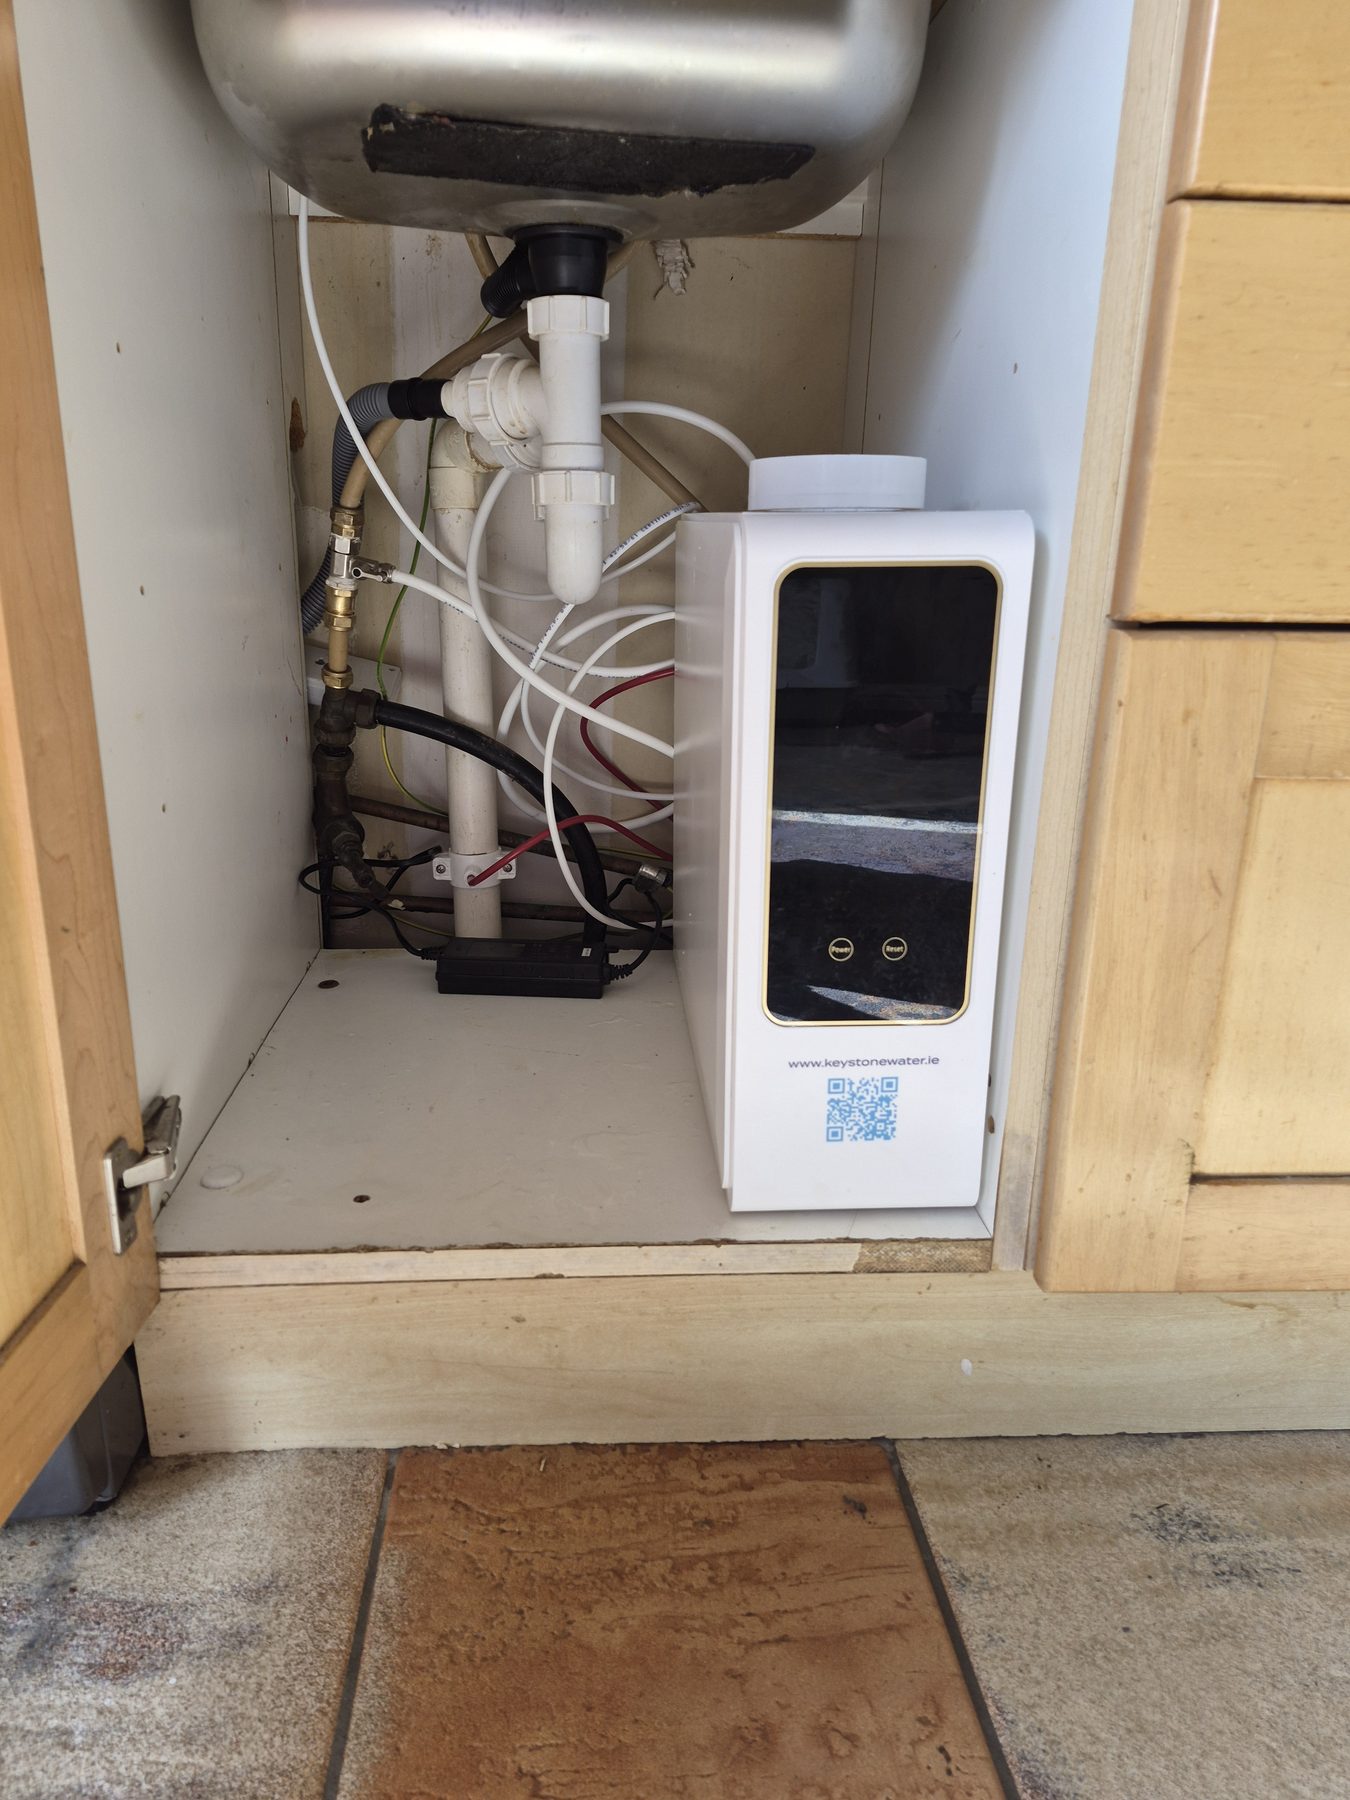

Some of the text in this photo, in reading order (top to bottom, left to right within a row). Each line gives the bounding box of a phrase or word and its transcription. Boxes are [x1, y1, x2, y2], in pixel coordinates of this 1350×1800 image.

[831, 945, 851, 953] Power
[885, 945, 904, 953] Reset
[788, 1055, 940, 1068] www.keystonewater.ie
